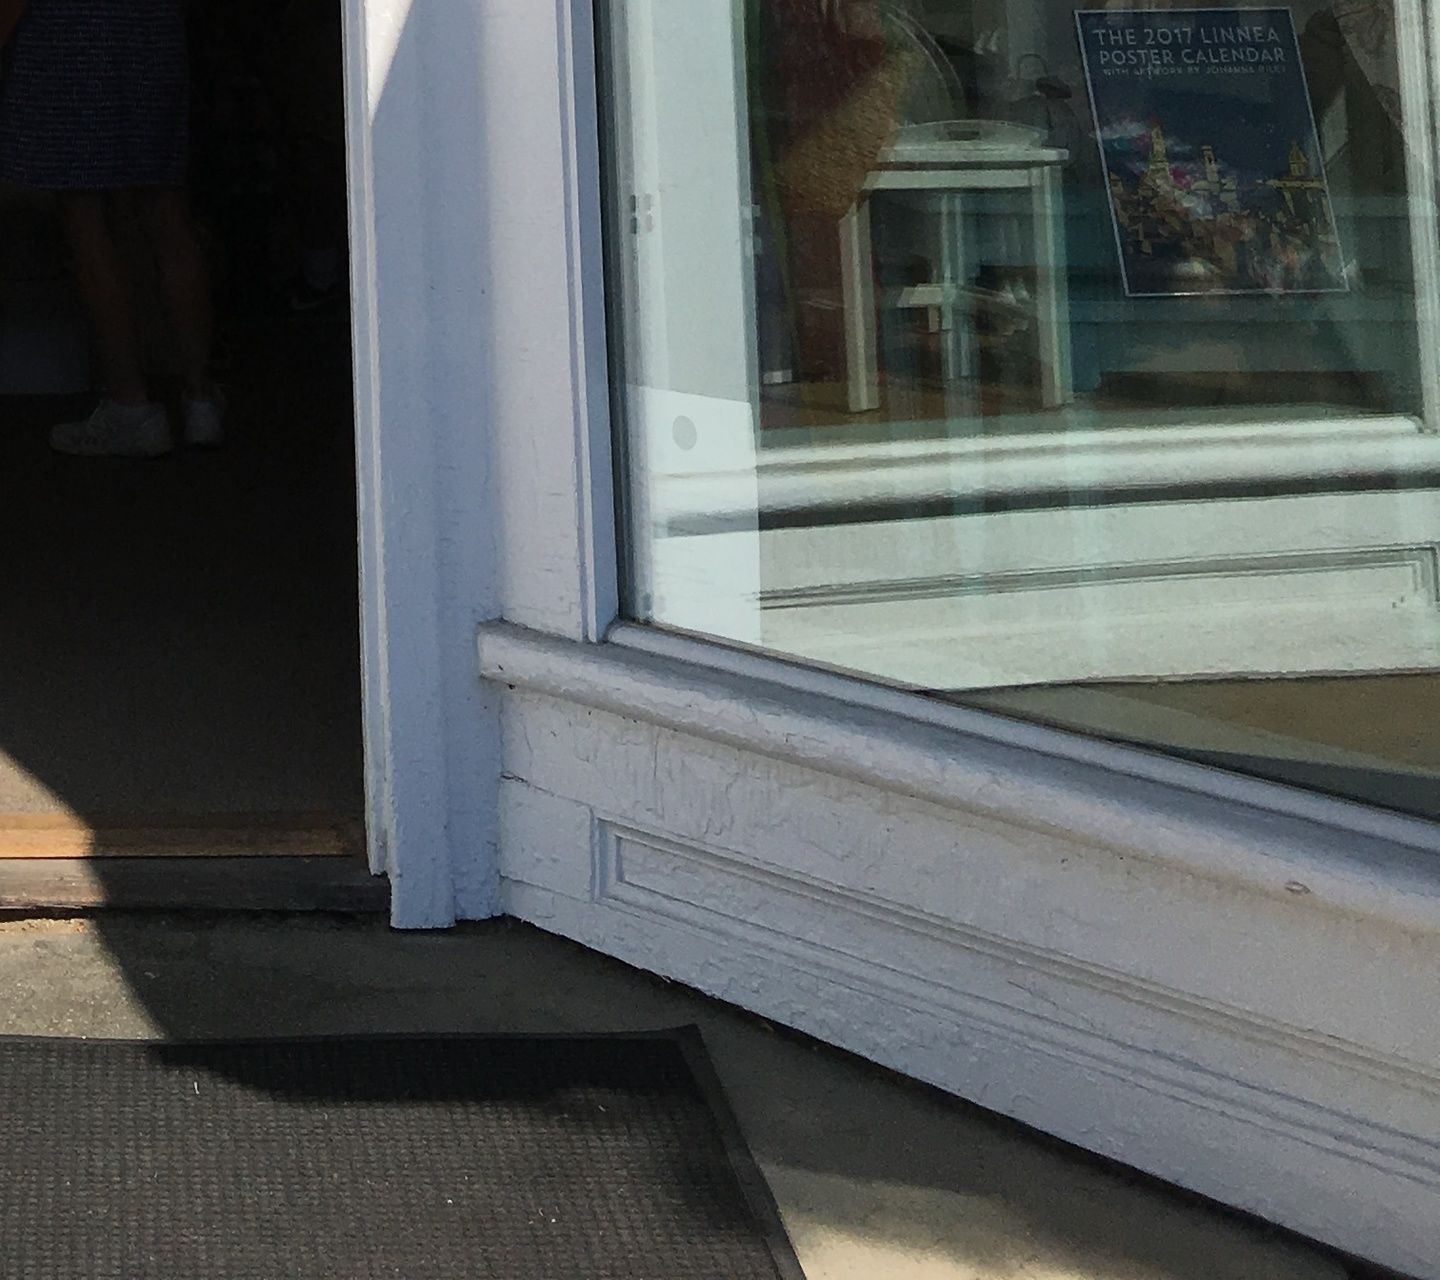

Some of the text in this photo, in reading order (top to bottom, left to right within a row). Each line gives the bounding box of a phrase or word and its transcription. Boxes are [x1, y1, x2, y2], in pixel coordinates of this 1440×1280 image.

[1092, 26, 1281, 46] THE 2017 LINNEA
[1099, 47, 1287, 65] POSTER CALENDAR
